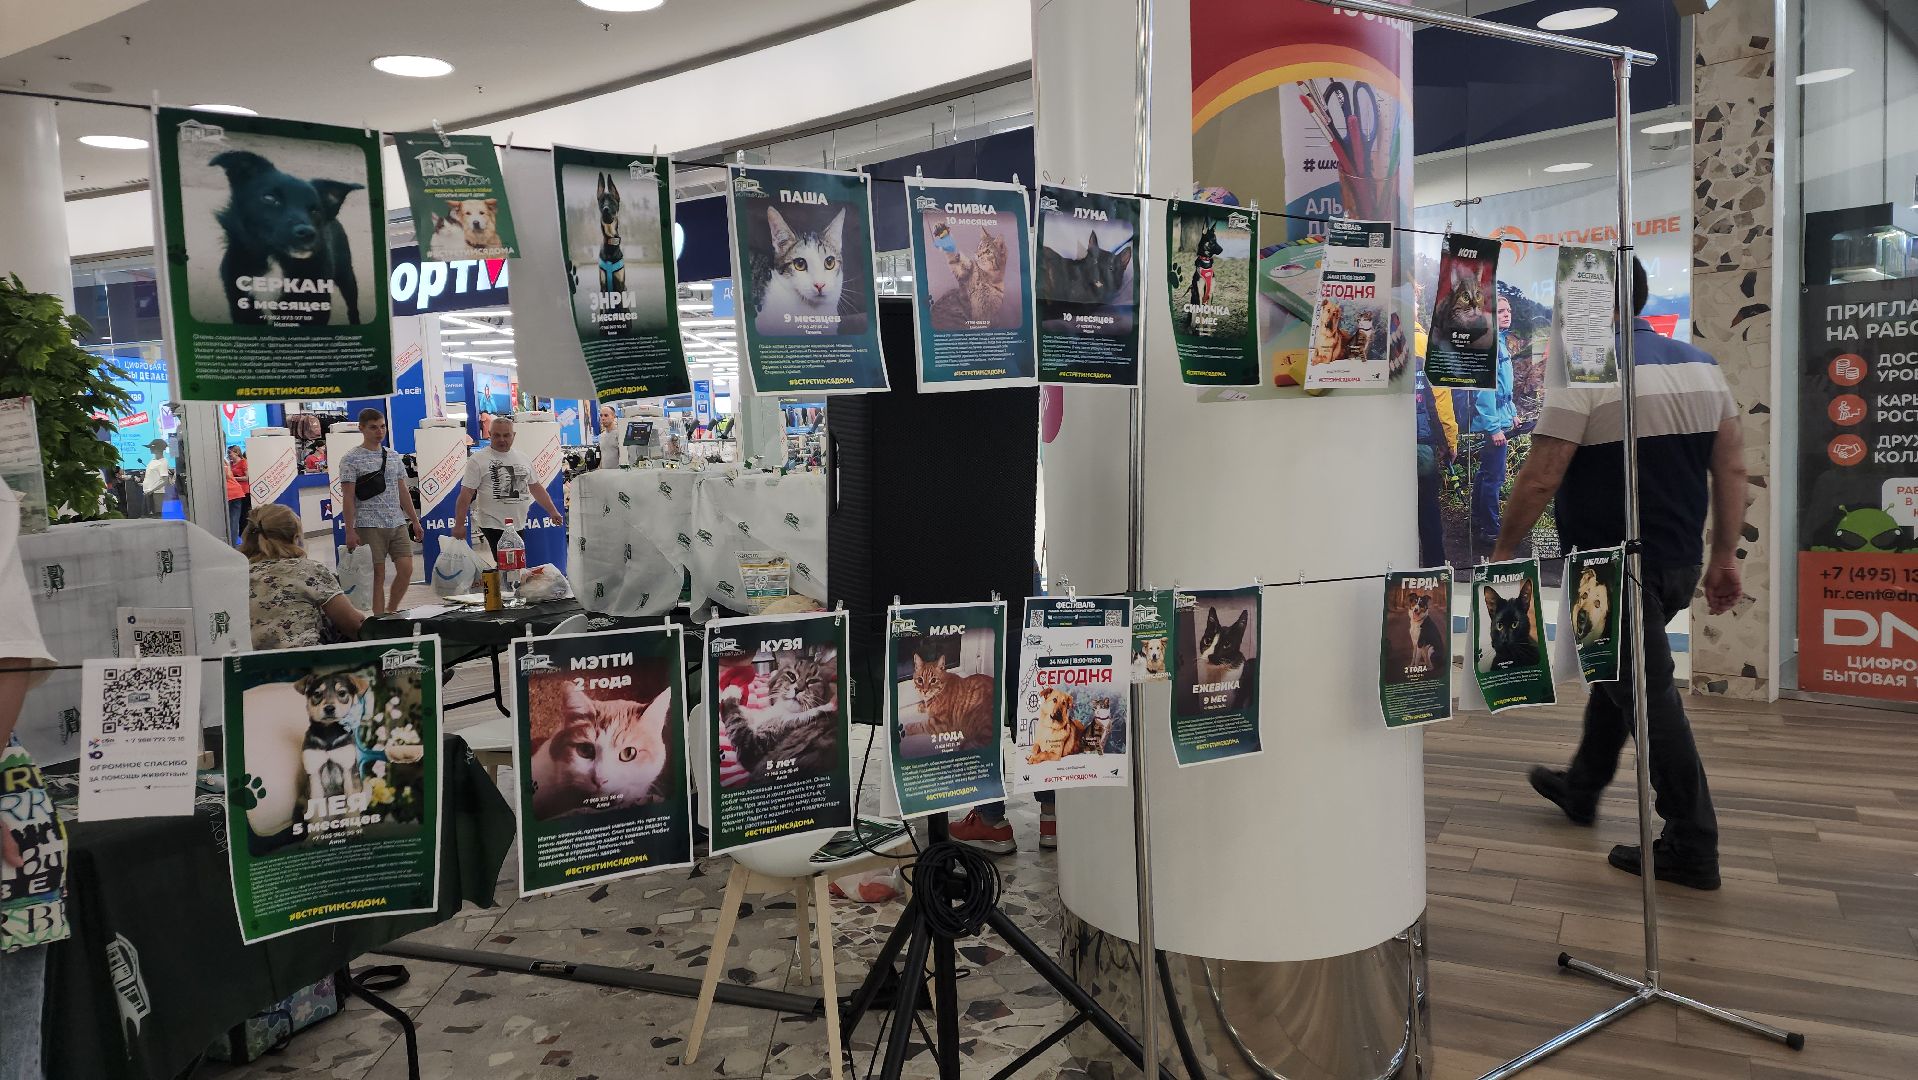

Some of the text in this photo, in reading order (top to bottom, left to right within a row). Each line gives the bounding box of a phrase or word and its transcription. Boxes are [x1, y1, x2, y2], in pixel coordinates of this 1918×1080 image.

[779, 189, 829, 206] ПАША
[944, 202, 997, 215] СЛИВКА
[1073, 207, 1109, 222] ЛУНА
[945, 216, 998, 227] 10 месяцев
[1533, 215, 1681, 251] OUTVENURE
[1457, 247, 1478, 259] КОТЯ
[236, 275, 334, 294] СЕРКАН
[1321, 284, 1376, 300] СЕГОДНЯ
[237, 297, 331, 312] 6 месяцев
[590, 291, 637, 310] ЭНРИ
[1183, 303, 1230, 316] СИМОЧКА
[591, 311, 638, 324] 5 месяцев
[783, 314, 842, 324] 9 месяцев
[1062, 312, 1114, 326] 10 месяцев
[1195, 316, 1218, 326] 8 МЕС
[1826, 325, 1859, 342] НА
[236, 386, 342, 397] #ВСТРЕТИМСЯДОМА
[426, 519, 445, 530] НА
[1819, 566, 1843, 581] +7
[1849, 566, 1897, 584] (495)
[1401, 576, 1439, 591] ГЕРДА
[1055, 601, 1096, 610] ФЕСТИВАЛЬ
[929, 624, 966, 637] МАРС
[760, 637, 803, 653] КУЗЯ
[570, 651, 634, 672] МЭТТИ
[1404, 665, 1428, 674] 2 ГОДА
[574, 673, 632, 692] 2 года
[1036, 668, 1113, 687] СЕГОДНЯ
[1823, 668, 1907, 688] БЫТОВАЯ
[1192, 679, 1241, 694] ЕЖЕВИКА
[1203, 694, 1228, 705] 9 МЕС
[931, 730, 965, 744] 2 ГОДА
[89, 761, 142, 771] ОГРОМНОЕ
[766, 757, 797, 770] 5 лет
[101, 773, 140, 782] ПОМОЩЬ
[303, 792, 373, 820] ЛЕЯ
[292, 813, 382, 836] 5 месяцев
[565, 854, 649, 877] #ВСТРЕТИМСЯДОМА
[288, 897, 388, 921] #ВСТРЕТИМСЯДОМА
